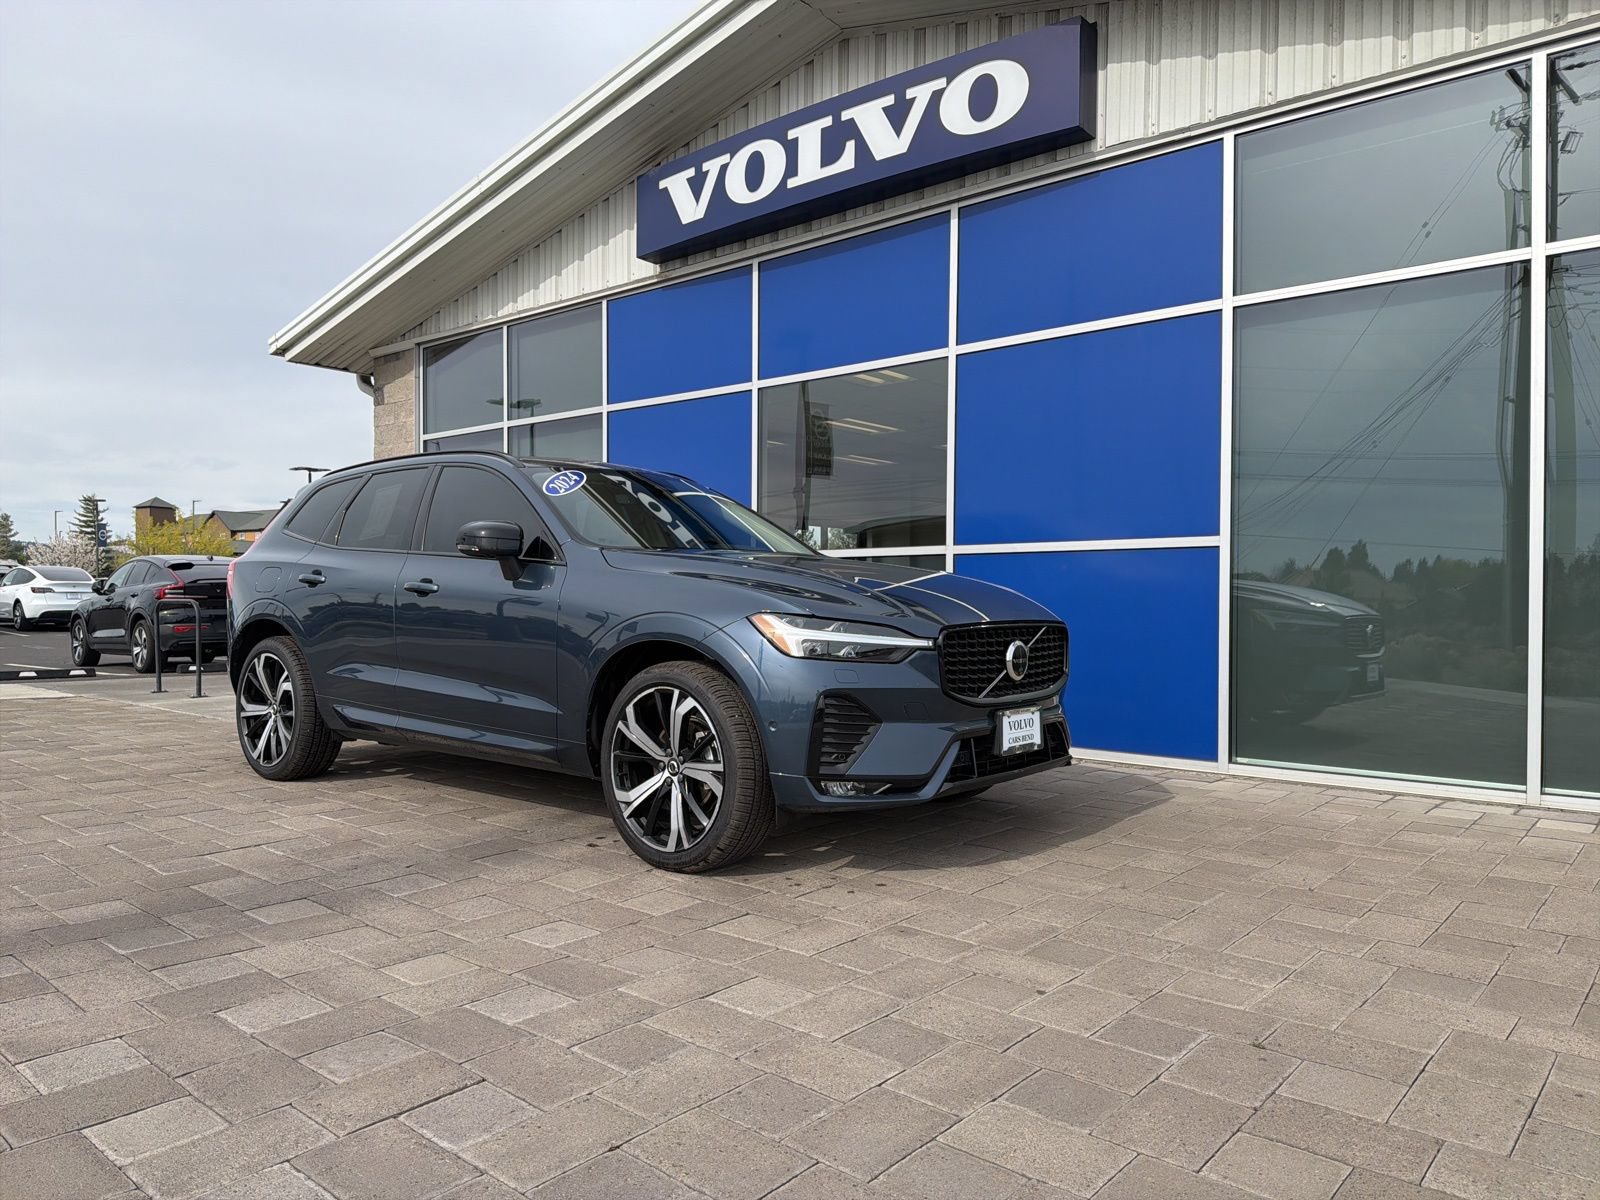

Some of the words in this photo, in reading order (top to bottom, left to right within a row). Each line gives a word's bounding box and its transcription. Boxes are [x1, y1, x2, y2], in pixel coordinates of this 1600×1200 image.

[659, 59, 1030, 225] VOLVO
[549, 472, 580, 493] 2024
[1008, 718, 1034, 731] VOLVO
[1008, 735, 1021, 744] CARS
